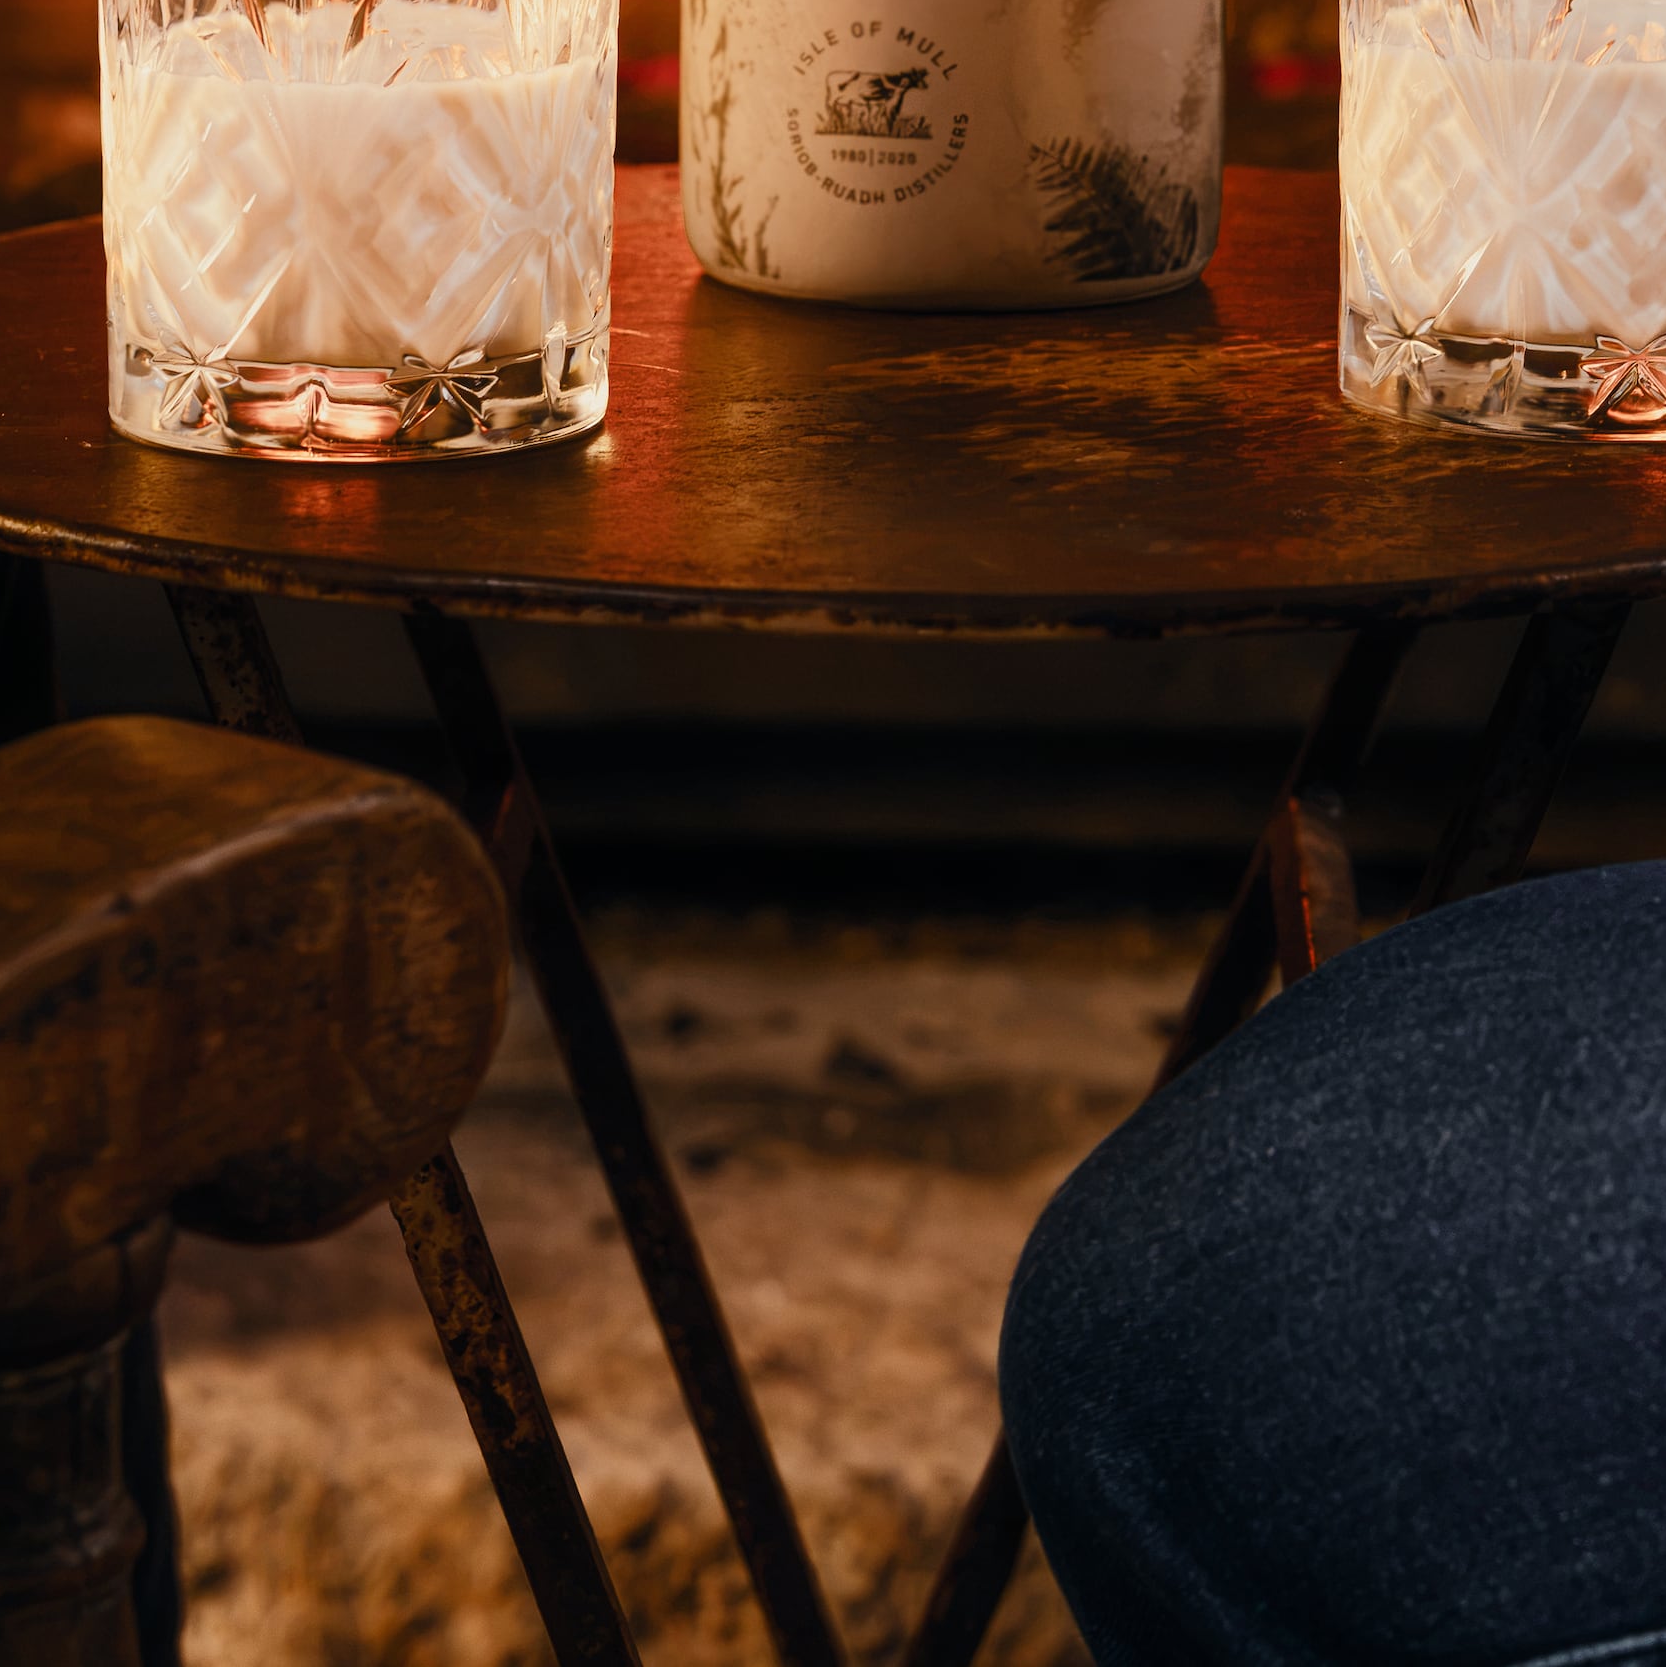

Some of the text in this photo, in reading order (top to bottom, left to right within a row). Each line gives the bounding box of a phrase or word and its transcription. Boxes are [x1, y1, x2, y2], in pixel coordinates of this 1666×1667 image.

[792, 20, 959, 81] ISLE OF MULL
[894, 113, 970, 203] DISTILLERS
